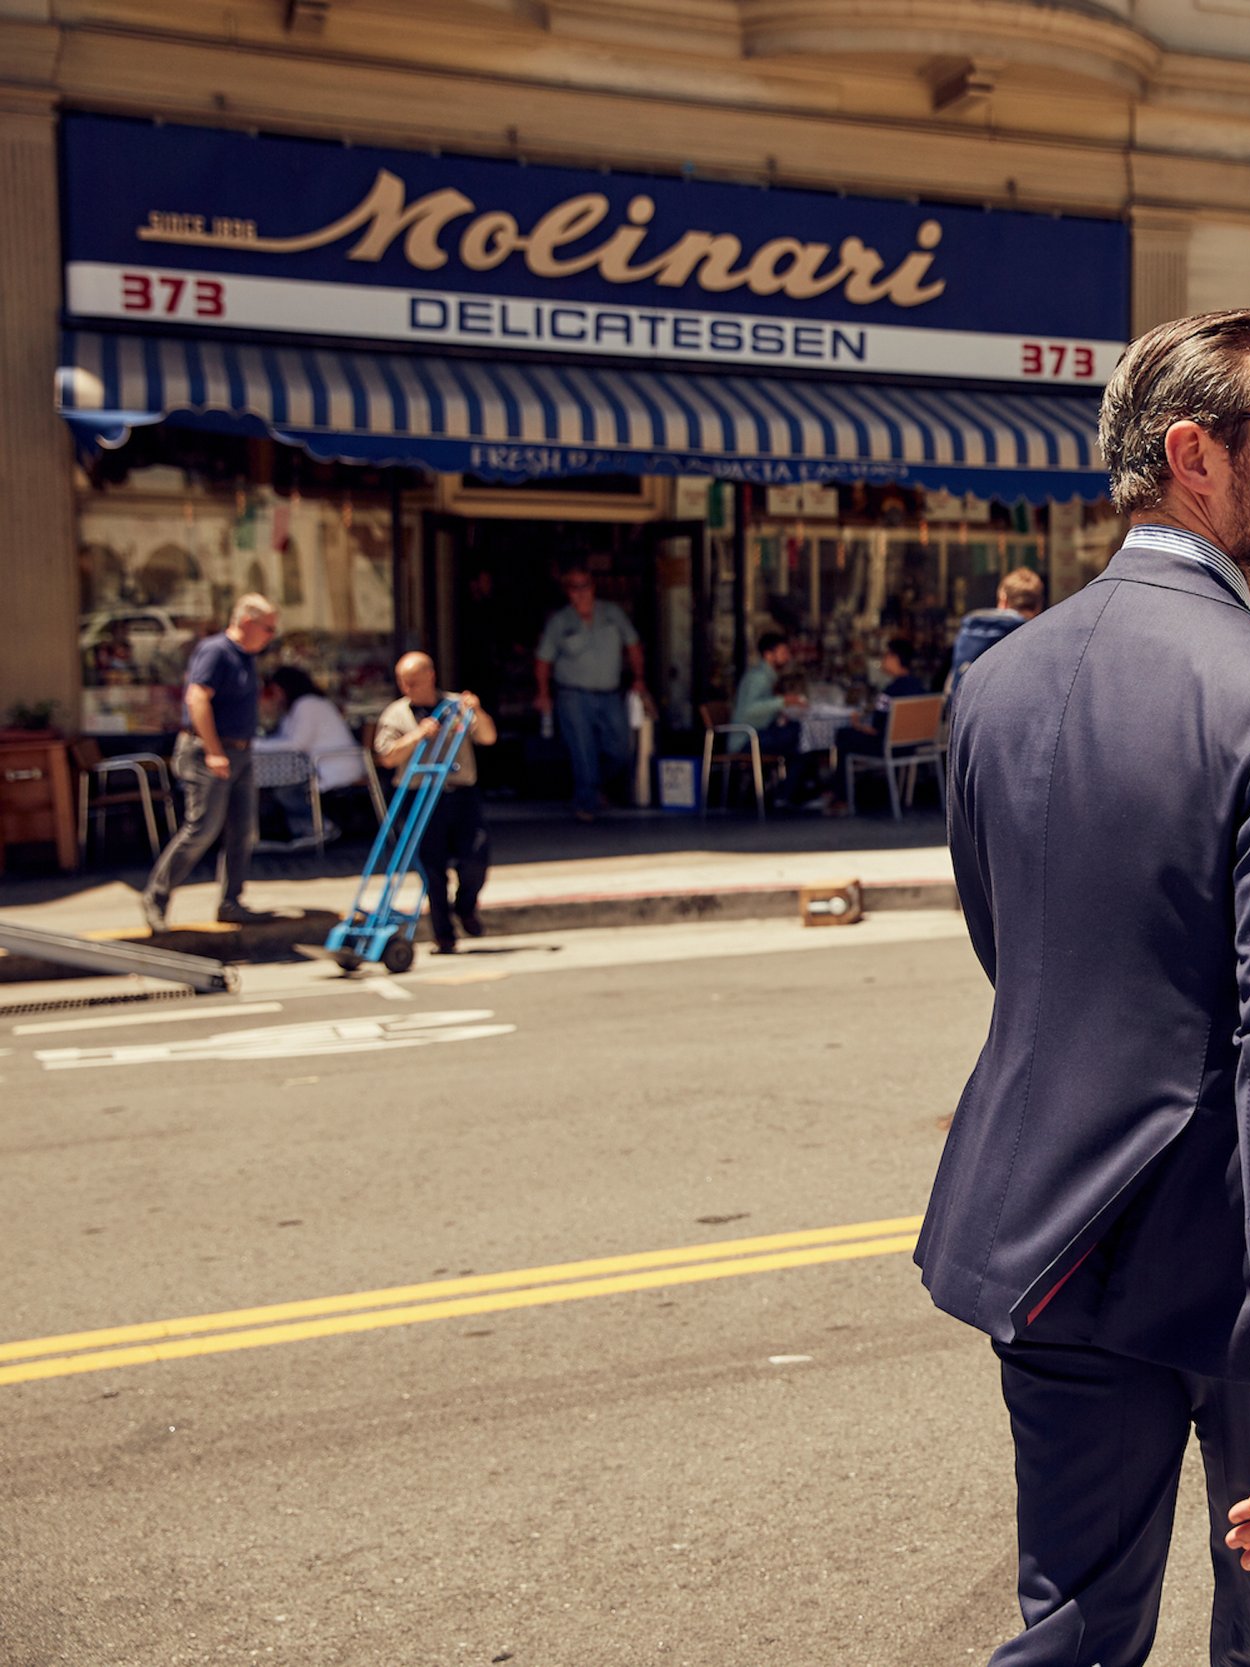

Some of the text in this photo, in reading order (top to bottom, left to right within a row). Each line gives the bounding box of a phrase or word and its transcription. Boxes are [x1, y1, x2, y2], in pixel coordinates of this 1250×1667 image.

[149, 211, 205, 234] SINCE
[345, 168, 946, 308] Molinari
[123, 273, 226, 318] 373
[410, 297, 868, 362] DELICATESSEN
[1021, 343, 1095, 378] 373
[470, 446, 563, 476] FRESH
